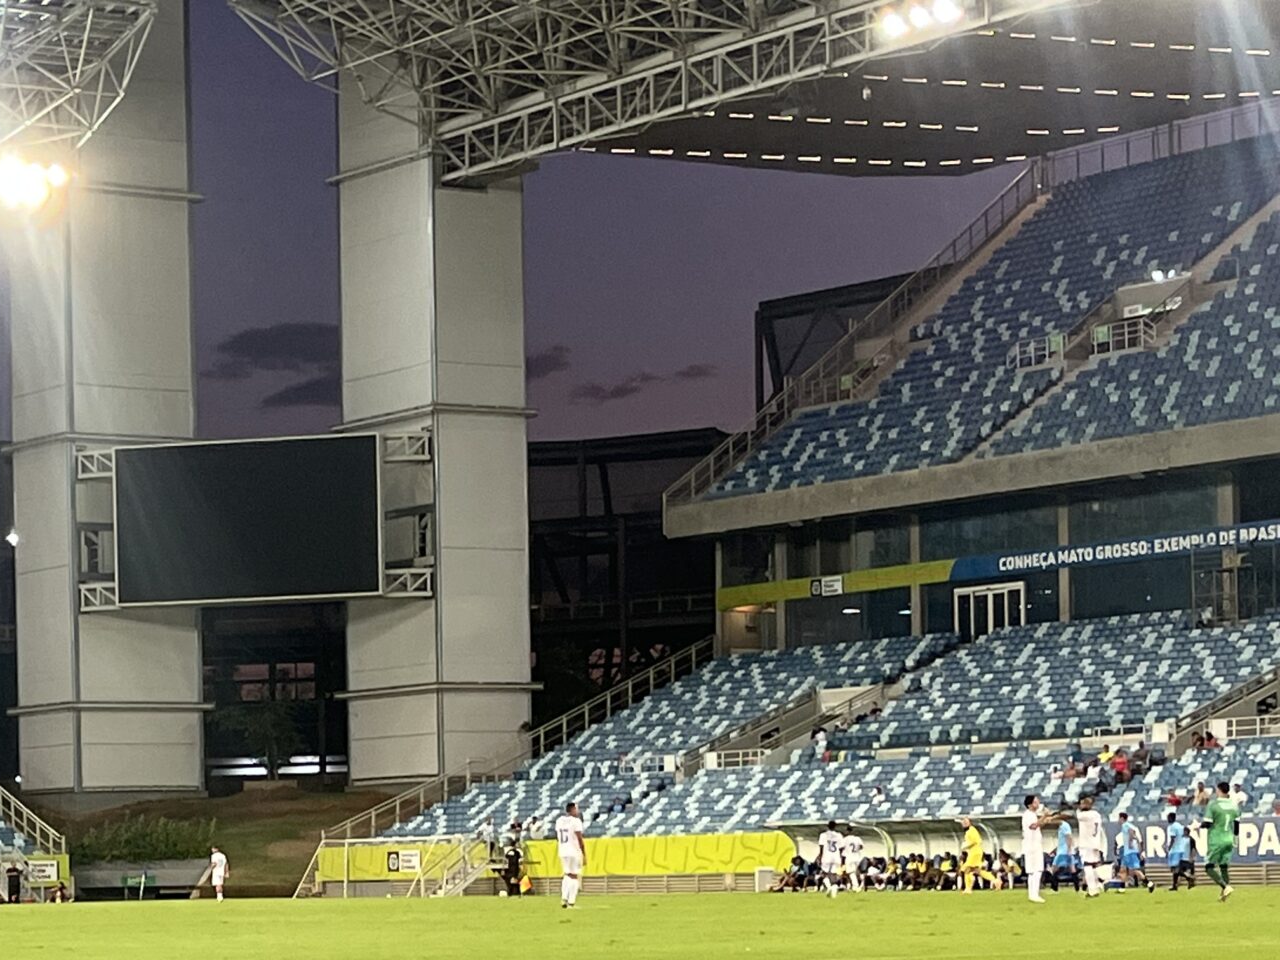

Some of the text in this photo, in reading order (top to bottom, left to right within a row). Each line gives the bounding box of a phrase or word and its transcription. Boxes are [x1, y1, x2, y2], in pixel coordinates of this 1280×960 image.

[999, 553, 1056, 571] CONHEÇA
[1057, 547, 1093, 565] MATO
[1095, 540, 1152, 560] GROSSO:
[1219, 530, 1237, 546] DE
